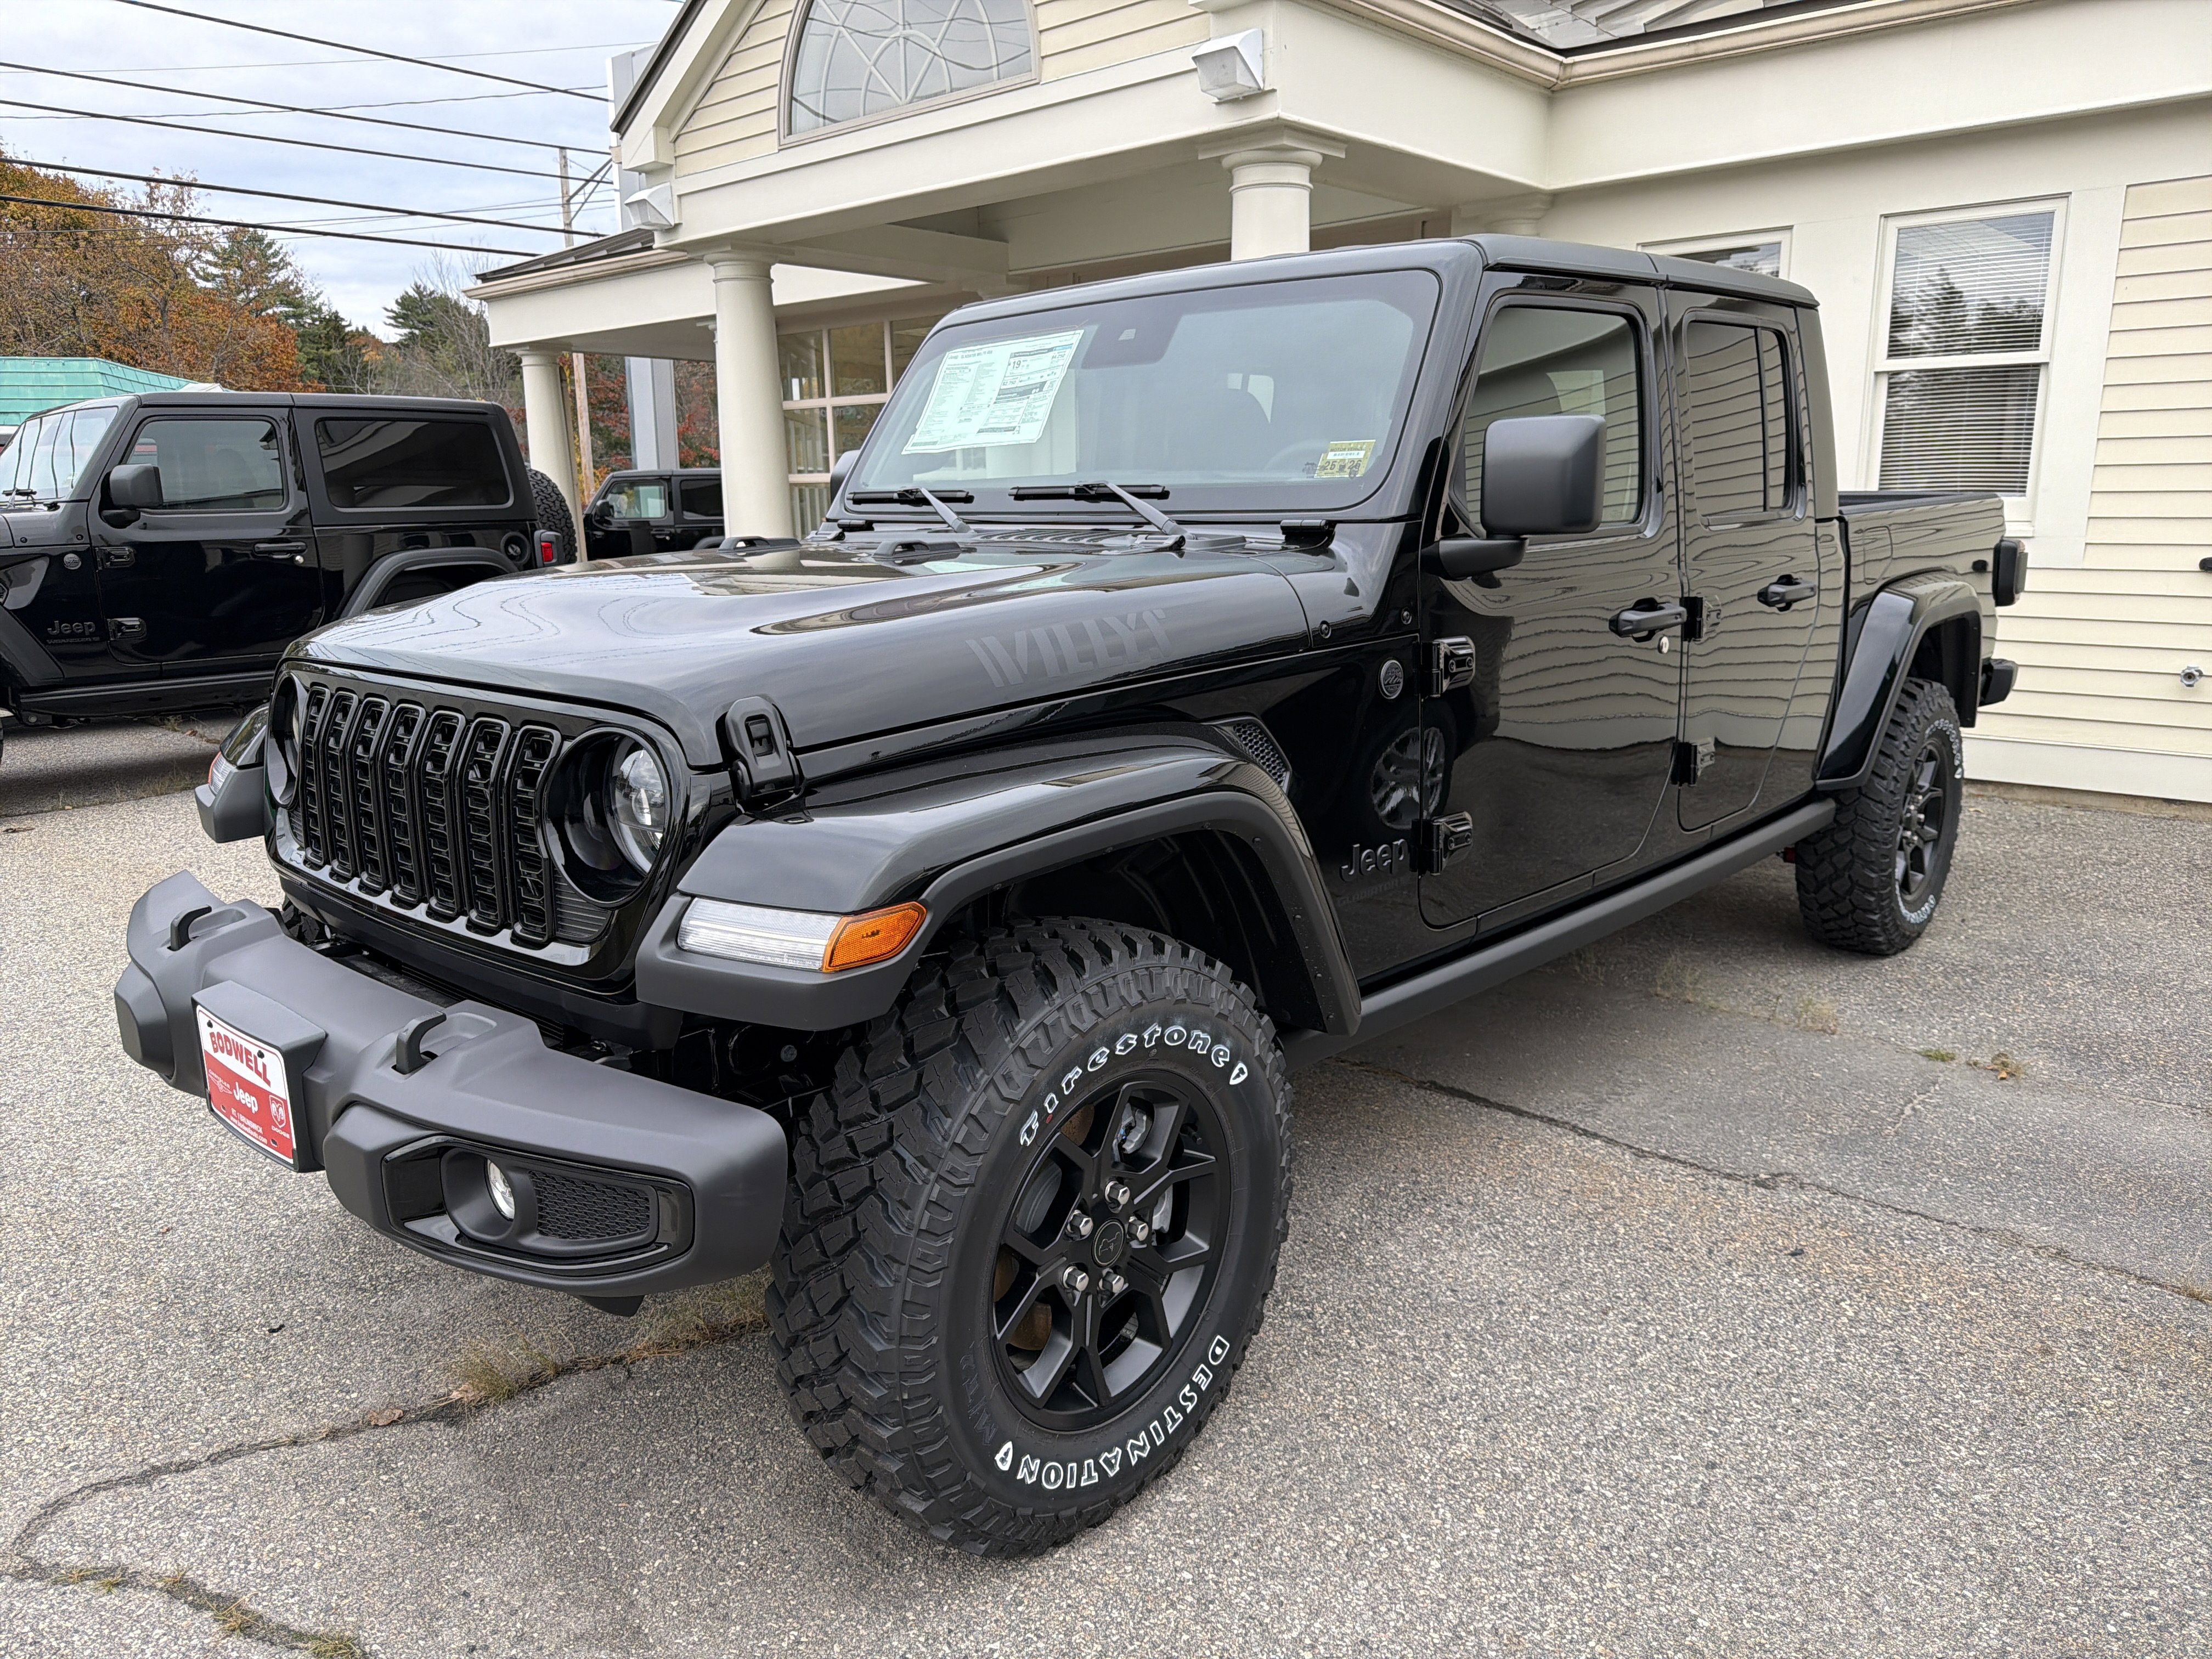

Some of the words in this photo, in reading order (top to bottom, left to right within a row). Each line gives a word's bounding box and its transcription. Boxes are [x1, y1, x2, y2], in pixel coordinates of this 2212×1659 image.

[1012, 360, 1021, 369] 19
[1325, 461, 1337, 470] 25
[1347, 460, 1362, 470] 26
[47, 620, 95, 636] Jeep
[965, 608, 1173, 688] WILLYS
[1340, 838, 1409, 882] Jeep
[209, 1031, 271, 1088] BODWELL
[233, 1081, 258, 1114] Jeep
[1020, 1023, 1229, 1146] Firestone
[271, 1125, 290, 1139] DODGE
[1017, 1335, 1229, 1489] DESTINATION
